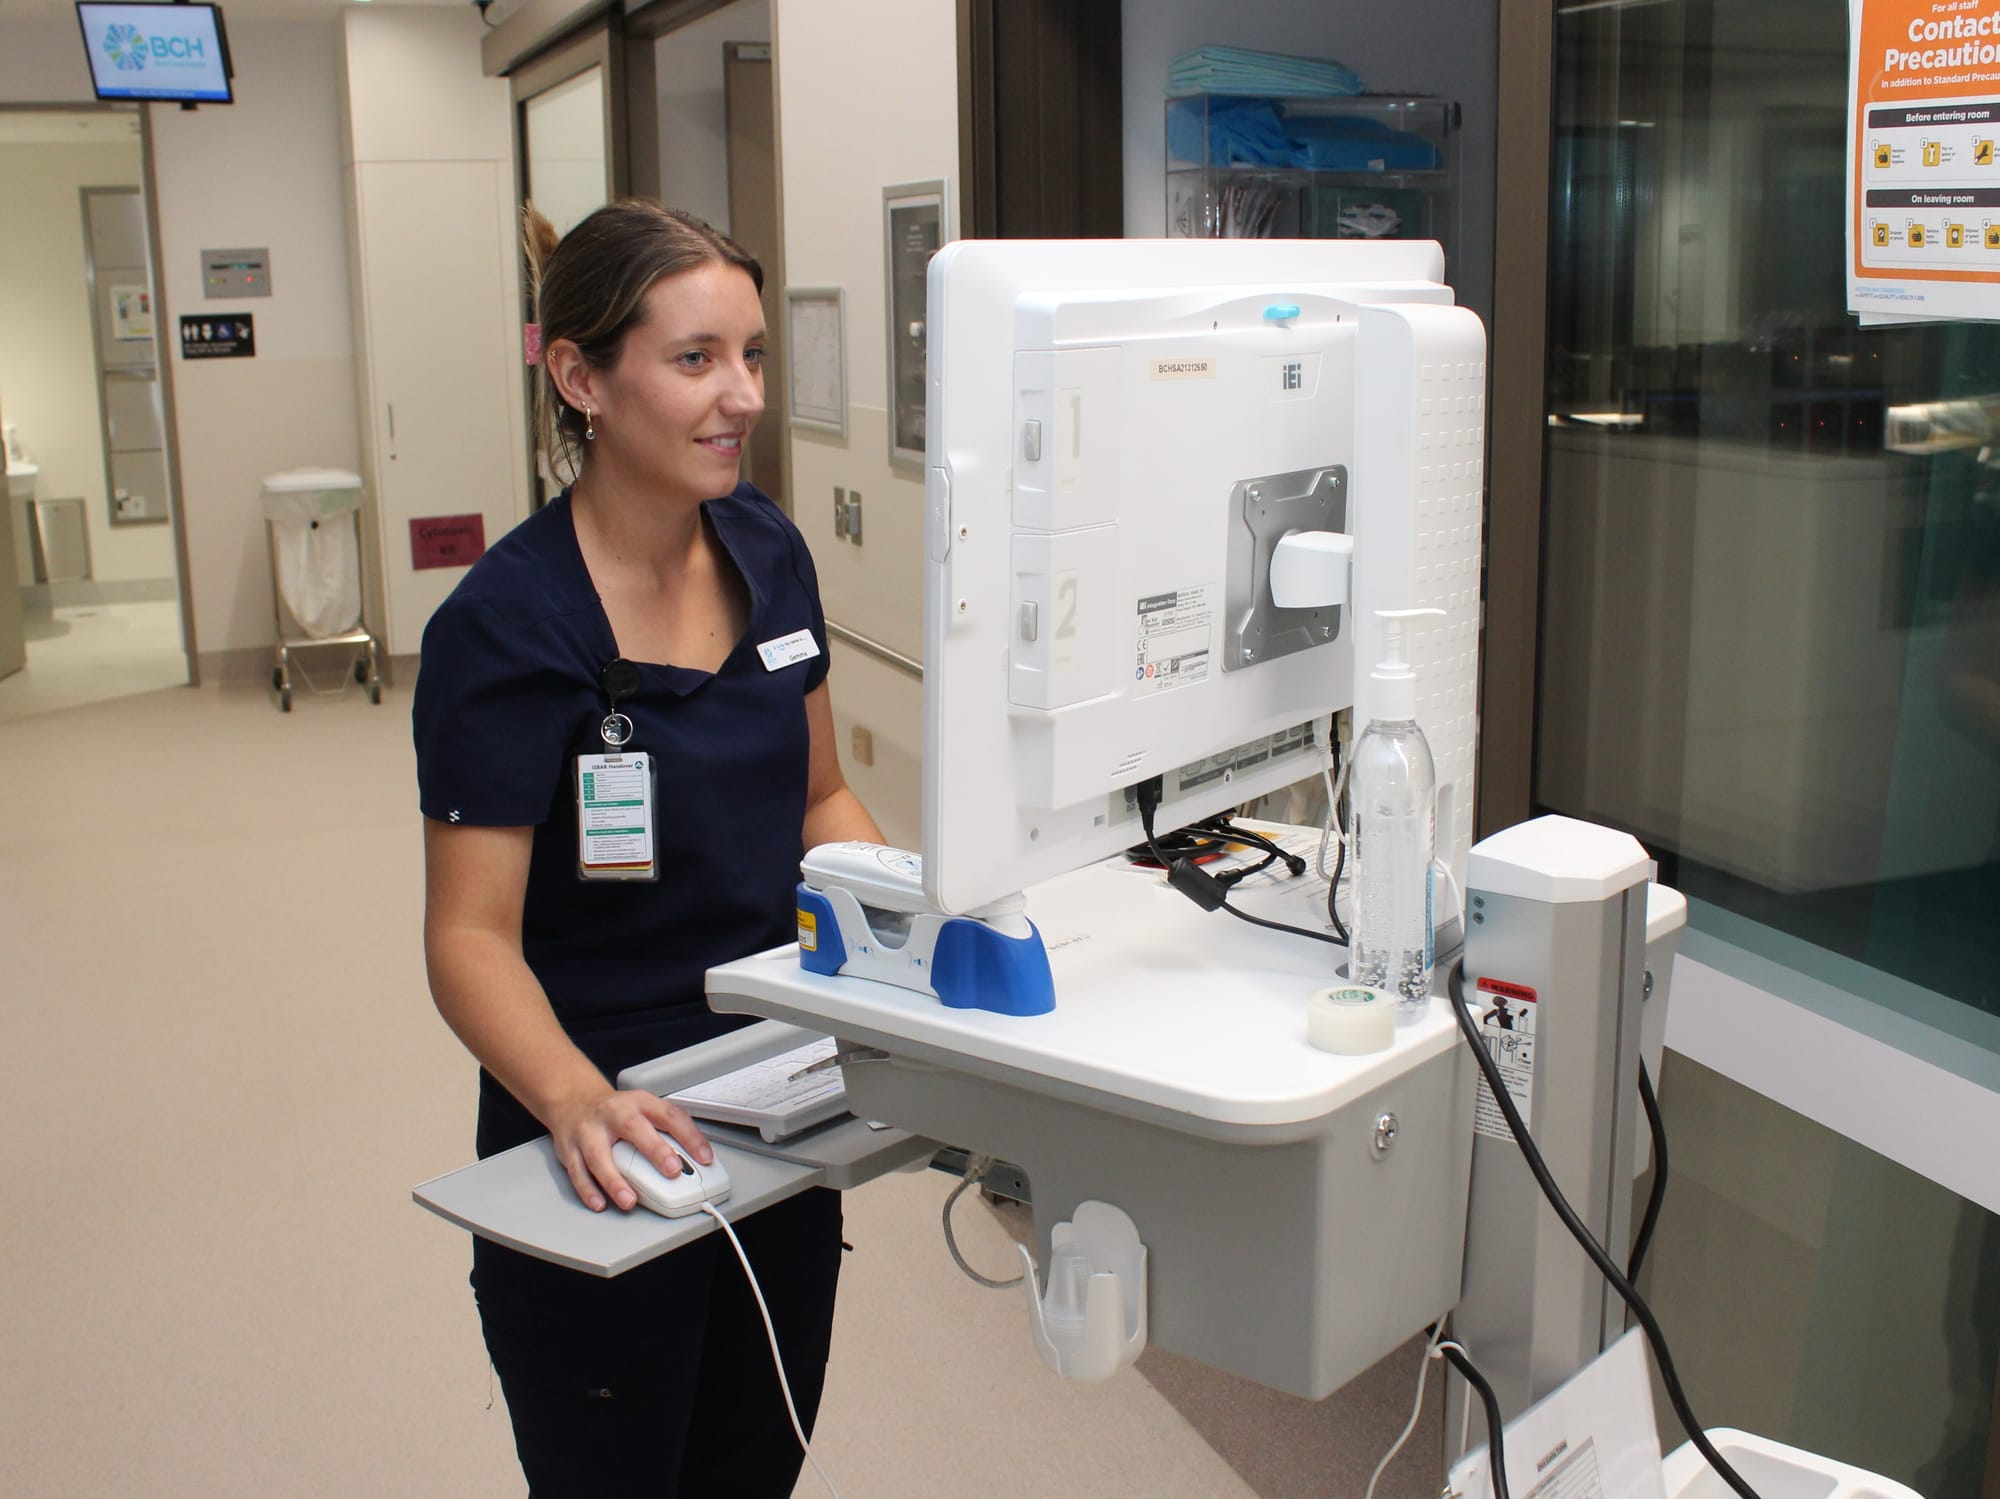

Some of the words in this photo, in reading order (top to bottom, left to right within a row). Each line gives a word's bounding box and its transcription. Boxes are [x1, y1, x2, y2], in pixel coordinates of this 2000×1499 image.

[1932, 4, 1946, 13] For
[1947, 2, 1957, 11] all
[1958, 0, 1979, 10] staff
[1908, 11, 2000, 42] Contact
[150, 36, 204, 58] BCH
[1882, 80, 1889, 88] in
[1890, 77, 1922, 88] addition
[1923, 77, 1932, 85] to
[1933, 73, 1970, 85] Standard
[1905, 113, 1931, 122] Before
[1933, 111, 1966, 122] entering
[1967, 110, 1990, 119] room
[1911, 194, 1922, 203] On
[1924, 194, 1952, 204] leaving
[1953, 195, 1975, 203] room
[1070, 395, 1081, 458] 1
[1055, 577, 1077, 640] 2
[1490, 983, 1535, 1000] WARNING
